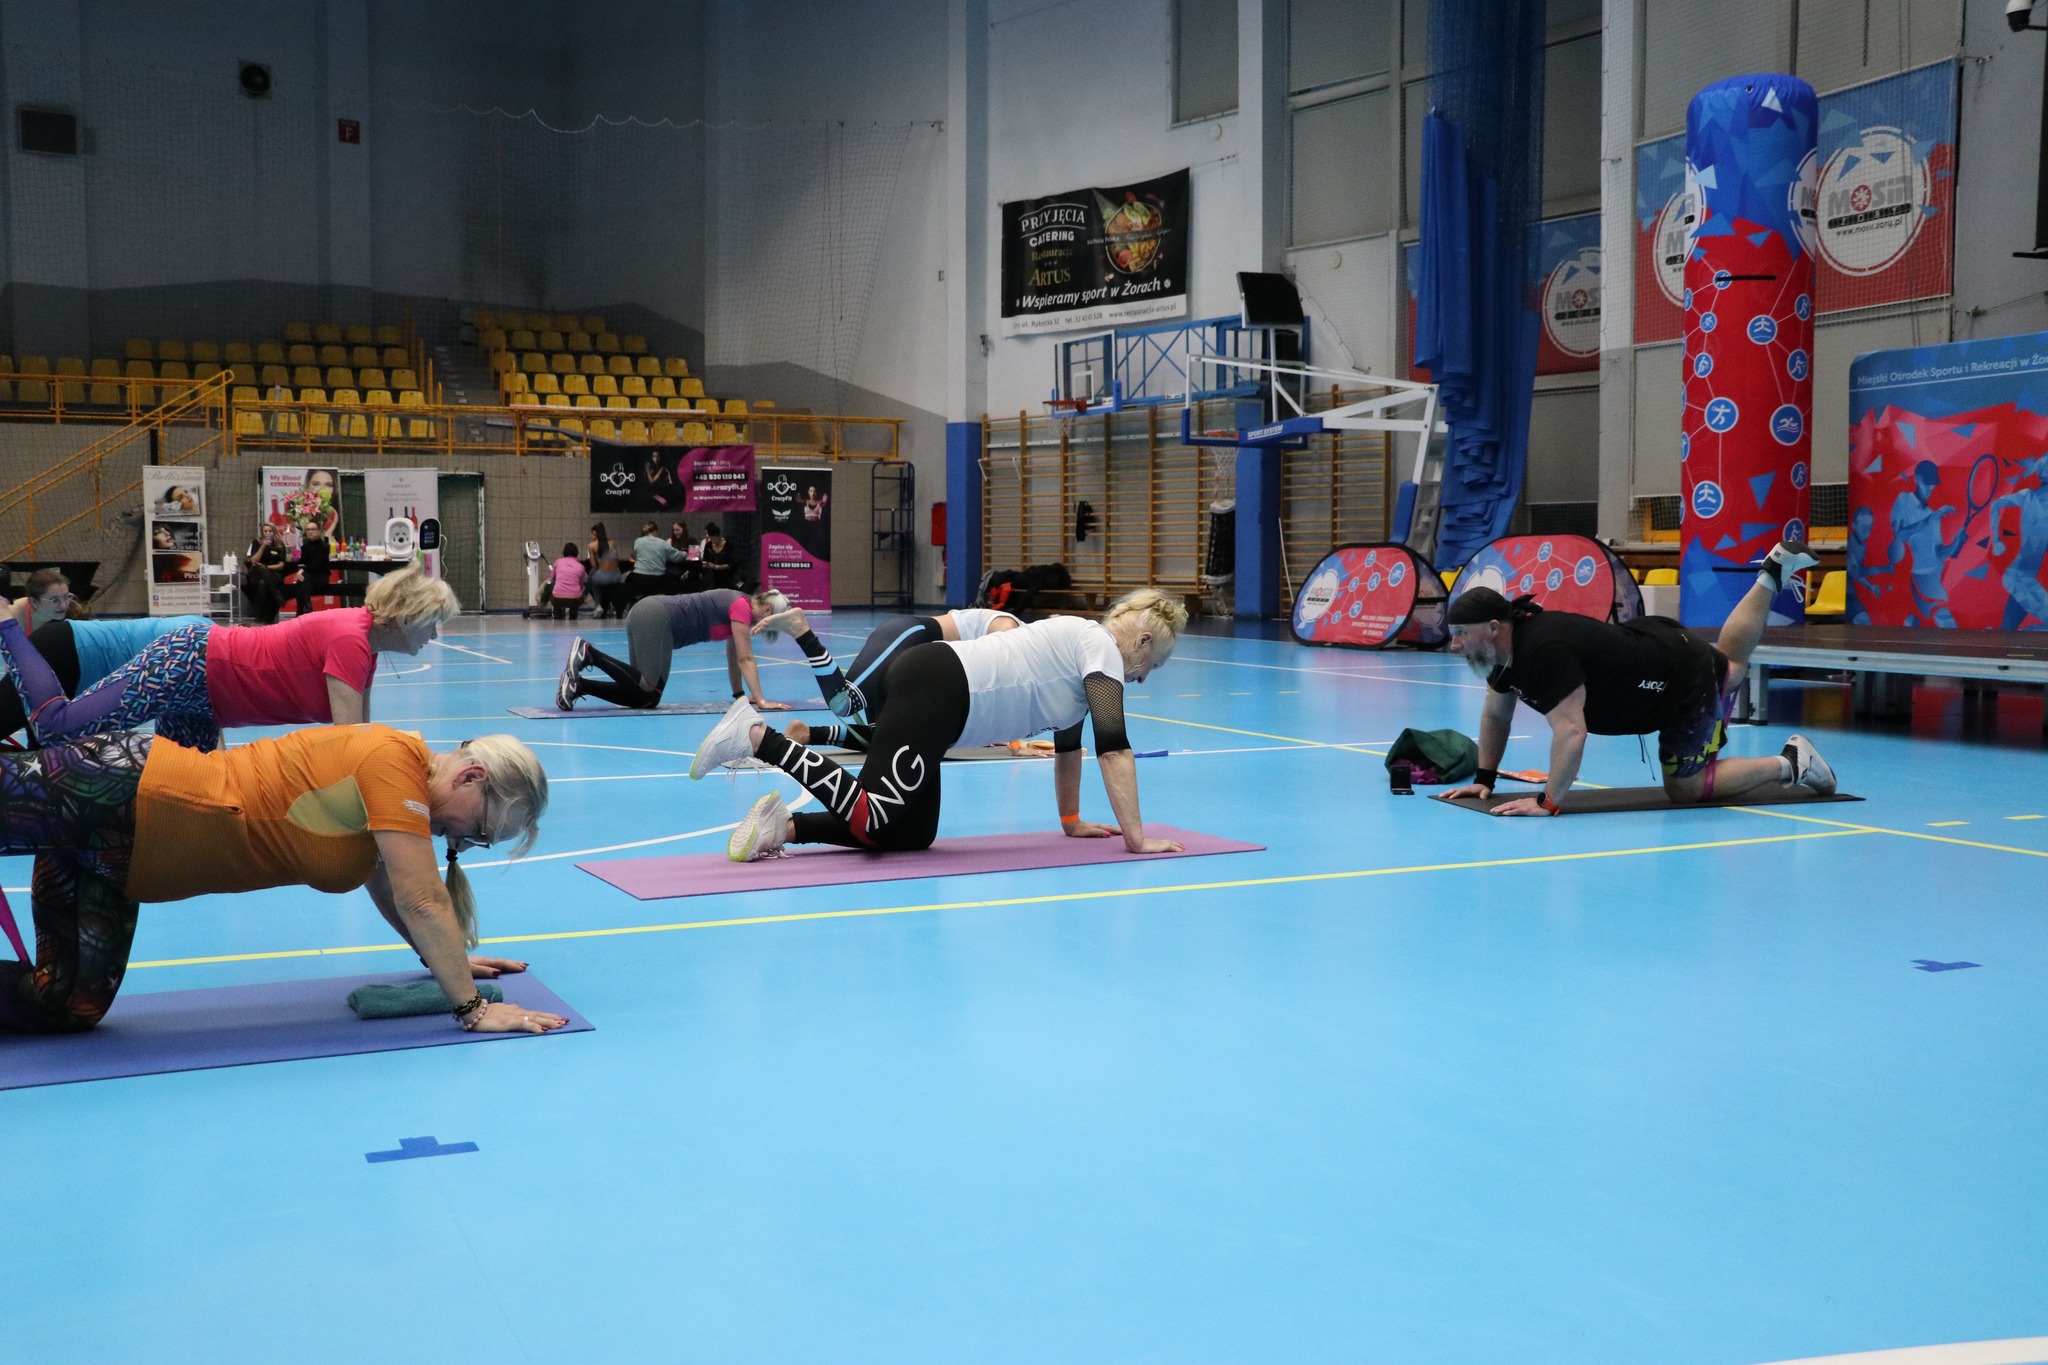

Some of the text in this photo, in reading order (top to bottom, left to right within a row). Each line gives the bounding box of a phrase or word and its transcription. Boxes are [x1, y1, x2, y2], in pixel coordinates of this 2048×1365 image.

[1021, 208, 1085, 232] PRZYJĘCIA
[1029, 230, 1075, 248] CATERING
[1022, 276, 1161, 310] Wspieramy sport w Żorach
[1857, 375, 1887, 386] Miejski
[1930, 365, 1963, 378] Sportu
[1971, 357, 2018, 371] Rekreacji
[2019, 358, 2031, 367] w
[693, 483, 748, 492] www.crazyfit.pl
[771, 495, 793, 503] CrazyFit
